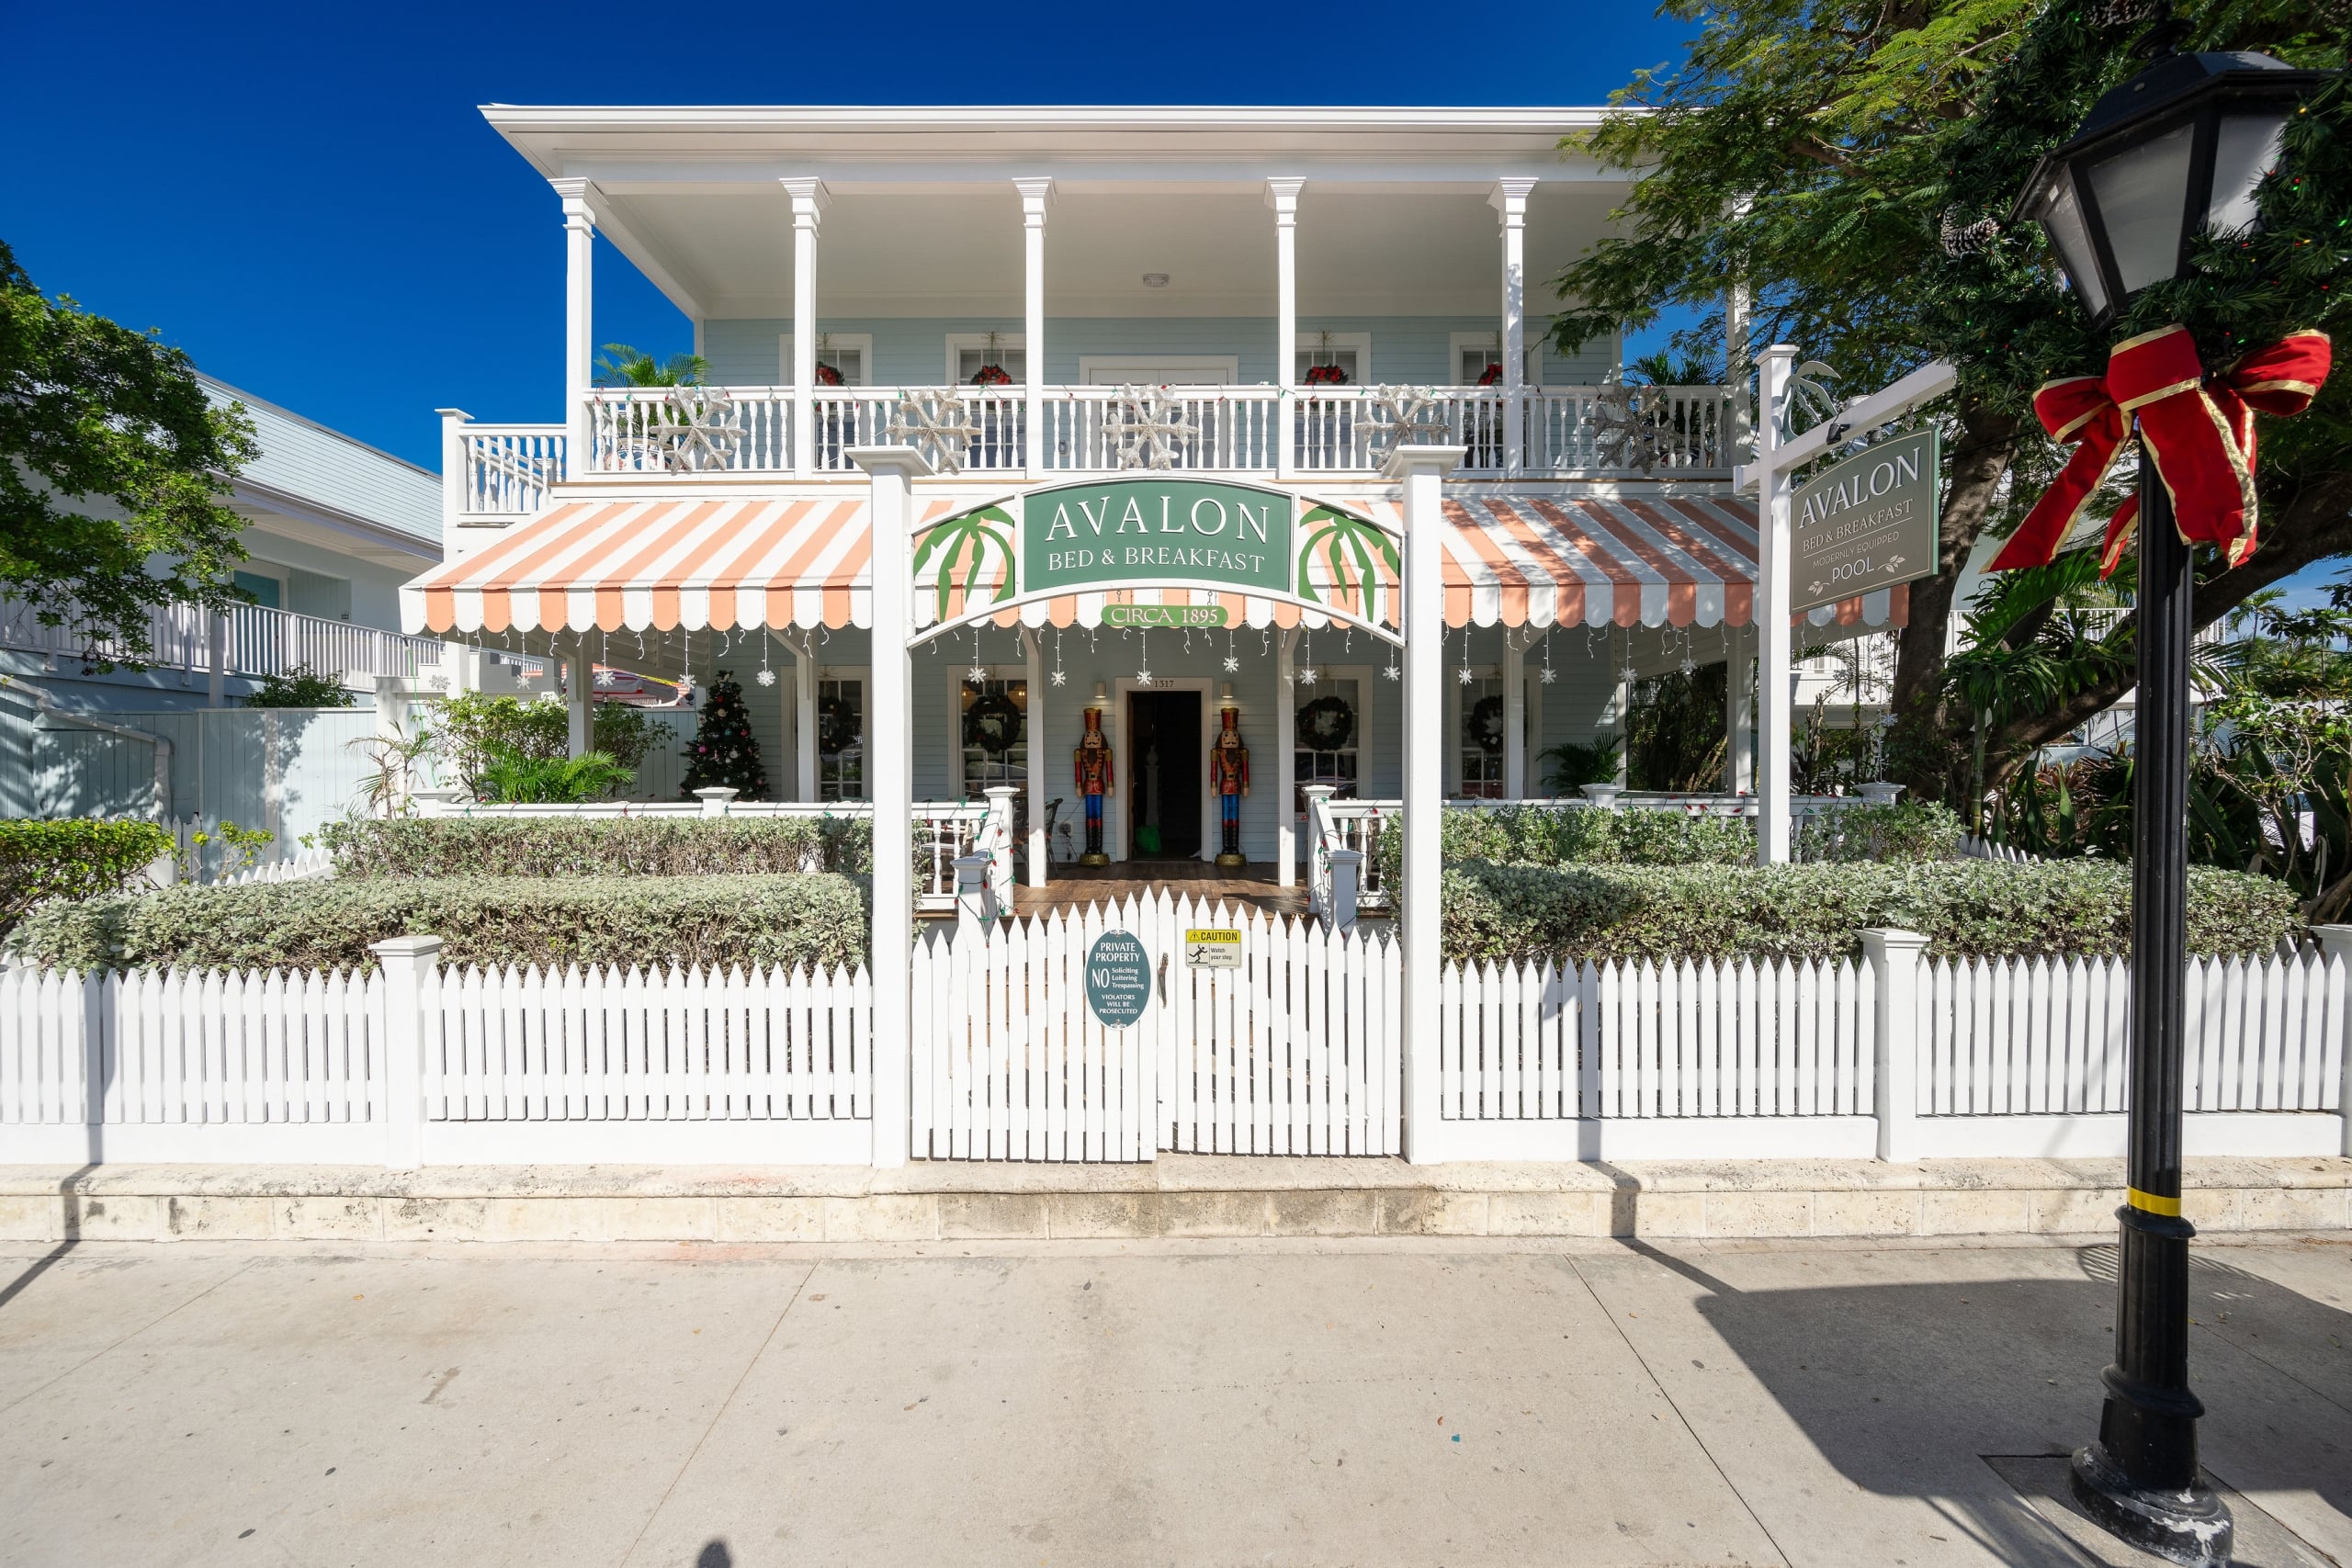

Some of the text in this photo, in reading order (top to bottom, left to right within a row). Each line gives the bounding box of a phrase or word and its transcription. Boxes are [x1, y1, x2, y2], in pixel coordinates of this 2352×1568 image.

[1799, 446, 1921, 529] AVALON
[1045, 496, 1269, 544] AVALON
[1804, 499, 1913, 551] BED & BREAKFAST
[1813, 531, 1900, 568] MODERNLY EQUIPPED
[1048, 547, 1264, 573] BED & BREAKFAST
[1832, 556, 1874, 583] POOL
[1111, 607, 1218, 624] CIRCA 1895
[1154, 680, 1174, 688] 1317
[1201, 931, 1238, 941] CAUTION
[1100, 942, 1136, 952] PRIVATE
[1095, 952, 1140, 963] PROPERTY
[1091, 968, 1110, 988] NO
[1112, 982, 1145, 990] Trespassing
